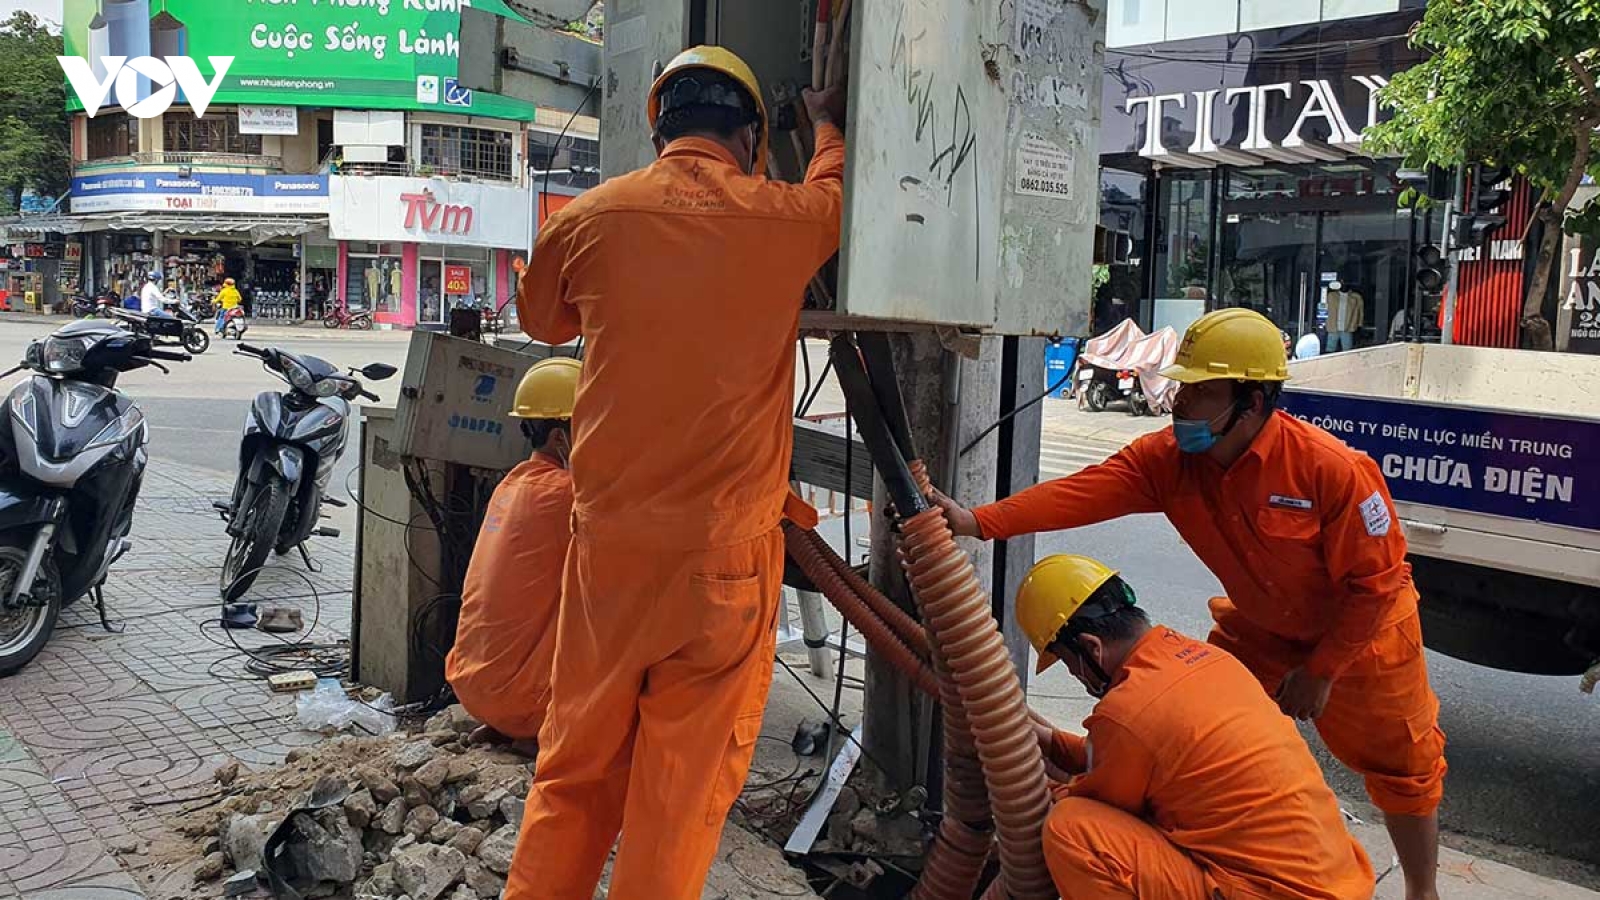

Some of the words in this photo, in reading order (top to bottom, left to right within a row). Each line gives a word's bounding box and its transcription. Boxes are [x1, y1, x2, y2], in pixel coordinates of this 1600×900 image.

[251, 23, 313, 58] Cuộc
[325, 21, 387, 59] Sống
[399, 28, 460, 57] Lành
[155, 178, 200, 189] Panasonic
[274, 181, 321, 190] Panasonic
[1020, 177, 1069, 195] 0862.035.525
[1490, 240, 1523, 260] NAM
[1311, 414, 1354, 433] CÔNG
[1358, 421, 1378, 436] TY
[1382, 422, 1419, 441] ĐIỆN
[1423, 428, 1456, 446] LỰC
[1460, 430, 1503, 450] MIỀN
[1508, 438, 1573, 458] TRUNG
[1382, 453, 1472, 489] CHỮA
[1484, 466, 1574, 503] ĐIỆN
